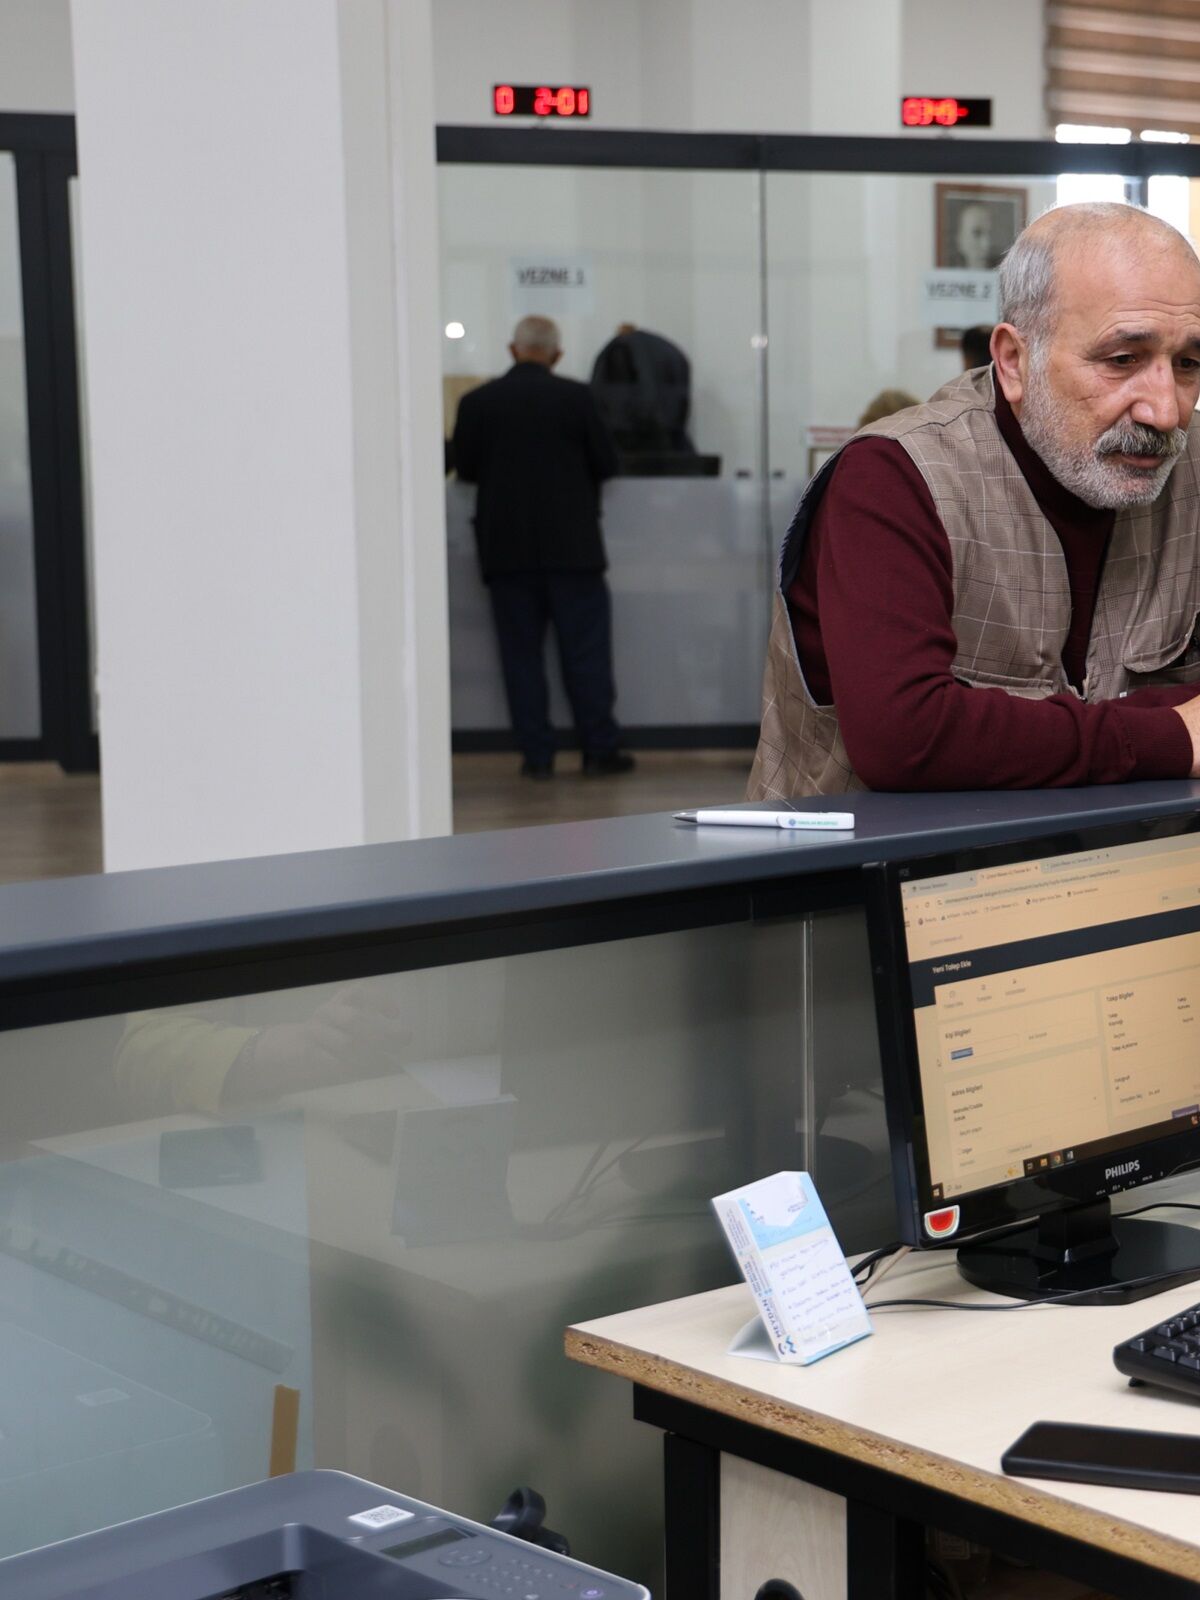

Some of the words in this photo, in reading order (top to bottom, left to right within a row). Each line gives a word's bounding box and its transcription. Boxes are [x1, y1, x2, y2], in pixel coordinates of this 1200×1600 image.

[518, 266, 568, 284] VEZNE
[928, 281, 976, 297] VEZNE
[1105, 1159, 1140, 1180] PHILIPS
